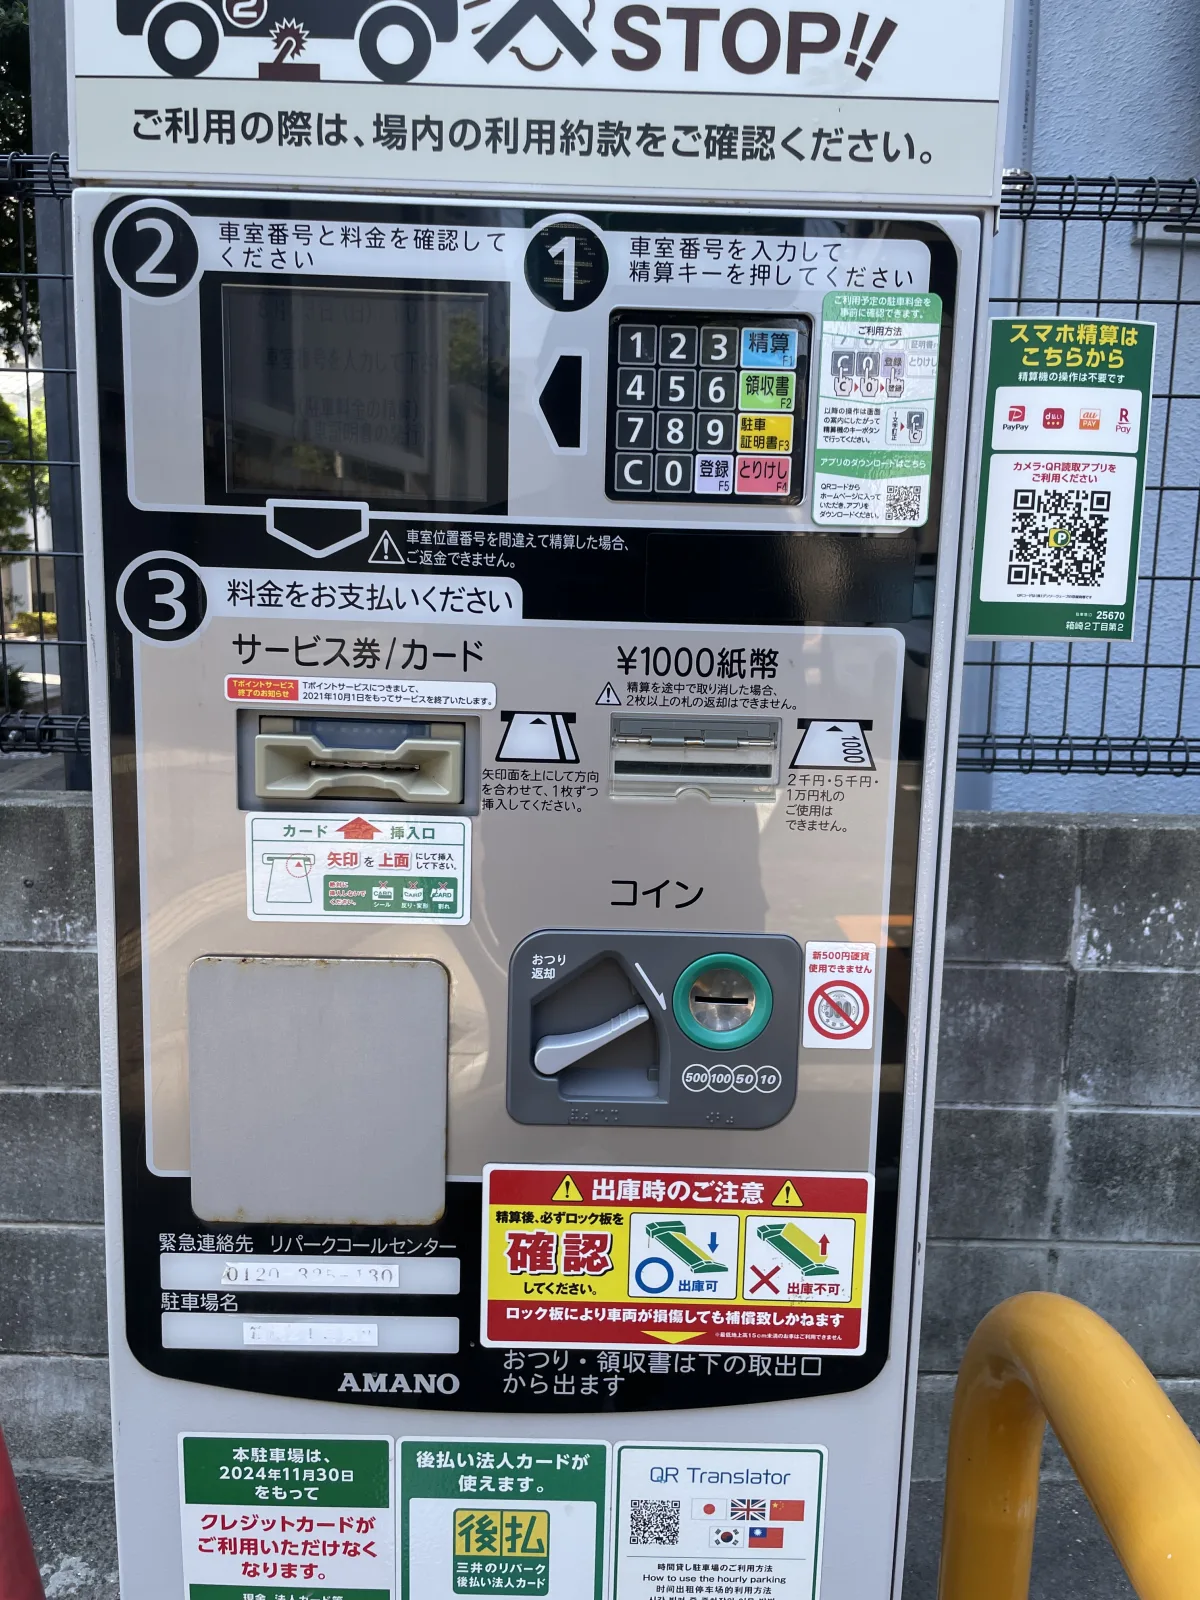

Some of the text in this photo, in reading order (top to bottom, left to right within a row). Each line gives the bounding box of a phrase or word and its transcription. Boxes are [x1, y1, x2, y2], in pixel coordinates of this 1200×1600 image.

[612, 4, 898, 82] STOP!!
[132, 107, 933, 165] ご利用の際は、場内の利用約款をご確認ください。
[218, 221, 506, 253] 車室番号と料金を確認して
[135, 218, 177, 284] 2
[628, 236, 842, 263] 車室番号を入力して
[221, 246, 314, 270] ください
[547, 236, 576, 301] 1
[628, 260, 914, 288] 精算キーを押してください
[834, 295, 932, 307] ご利用予定の駐車料金を
[839, 307, 924, 319] 事前に確認できます。
[858, 326, 903, 337] ご利用方法
[1010, 323, 1139, 347] スマホ精算は
[630, 332, 727, 361] 1 2 3
[749, 331, 790, 354] 精算
[782, 356, 794, 367] F1
[1021, 347, 1125, 369] こちらから
[1017, 371, 1126, 384] 精算機の操作は不要です
[626, 375, 726, 403] 4 5 6
[745, 375, 790, 397] 領収書
[780, 398, 792, 409] F2
[741, 418, 766, 432] 駐車
[823, 417, 880, 425] の案内にしたがって
[1002, 423, 1030, 432] PayPay
[1082, 420, 1097, 428] PAY
[627, 417, 724, 446] 7 8 9
[823, 426, 880, 434] 精算機のキーボタン
[1115, 425, 1131, 435] Pay
[740, 435, 778, 450] 証明書
[823, 435, 871, 443] で行ってください。
[699, 460, 730, 479] 登録
[739, 459, 787, 479] とりけし
[820, 458, 926, 469] アプリのダウンロードはこちら
[623, 459, 683, 487] C 0
[1031, 473, 1098, 484] ご利用ください
[718, 481, 730, 492] F5
[776, 481, 787, 493] F4
[820, 483, 860, 491] QRコードから
[820, 493, 881, 501] ホームページに入って
[819, 511, 880, 519] ダウンロードください。
[406, 529, 629, 553] 車室位置番号を間違えて精算した場合、
[406, 548, 516, 569] ご返金できません。
[146, 569, 187, 630] 3
[226, 579, 514, 614] 料金をお支払いください
[1096, 610, 1125, 621] 25670
[232, 632, 484, 673] サービス券/カード
[232, 680, 295, 690] Tポイントサービス
[302, 681, 419, 693] Tポイントサービスにつきまして、
[626, 681, 778, 696] 精算を途中で取り消した場合、
[237, 689, 290, 698] 終了のお知らせ
[302, 692, 493, 706] 2021年10月1日をもってサービスを終了いたします。
[626, 695, 797, 710] 2枚以上の札の返却はできません。
[841, 735, 866, 764] 1000
[482, 768, 599, 783] 矢印面を上にして方向
[481, 783, 599, 797] を合わせて、1枚ずつ
[786, 789, 845, 802] 1万円札の
[481, 798, 582, 812] 挿入してください。
[785, 804, 833, 817] ご使用は
[283, 824, 435, 840] カード 挿入口
[785, 818, 848, 833] できません。
[327, 852, 410, 868] 矢印 を 上面
[415, 853, 454, 862] にして挿入
[416, 861, 458, 871] して下さい。
[610, 879, 704, 909] コイン
[531, 954, 567, 966] おつり
[812, 951, 870, 961] 新500円硬貨
[531, 967, 556, 980] 返却
[809, 964, 873, 974] 使用できません
[685, 1072, 776, 1085] 500 100 50 10
[591, 1178, 764, 1205] 出庫時のご注意
[495, 1210, 624, 1227] 精算後、必ずロック板を
[159, 1233, 457, 1256] 緊急連絡先 リパークコールセンター
[505, 1231, 614, 1276] 確認
[523, 1281, 597, 1296] してください。
[678, 1279, 718, 1293] 出庫可
[787, 1281, 841, 1296] 出庫不可
[160, 1292, 239, 1312] 駐車場名
[505, 1306, 845, 1328] ロック板により車両が損傷しても補償致しかねます
[503, 1350, 823, 1377] おつり・領収書は下の取出口
[337, 1372, 461, 1395] AMANO
[503, 1375, 626, 1397] から出ます
[232, 1447, 332, 1464] 本駐車場は、
[416, 1450, 590, 1471] 後払い法人カードが
[219, 1465, 355, 1482] 2024年11月30日
[649, 1466, 792, 1486] QR Translator
[458, 1475, 545, 1494] 使えます。
[254, 1485, 320, 1500] をもって
[200, 1514, 377, 1534] クレジットカードが
[458, 1512, 546, 1555] 後払
[197, 1537, 378, 1558] ご利用いただけなく
[241, 1562, 326, 1581] なります。
[456, 1562, 547, 1576] 三井のリパーク
[657, 1563, 774, 1573] 時間貸し駐車場のご利用方法
[456, 1576, 546, 1590] 後払い法人カード
[642, 1574, 664, 1582] How
[667, 1574, 677, 1582] to
[699, 1575, 715, 1583] the
[717, 1575, 748, 1585] hourly
[750, 1575, 787, 1586] parking
[656, 1585, 773, 1595] 时间出租停车场的利用方法
